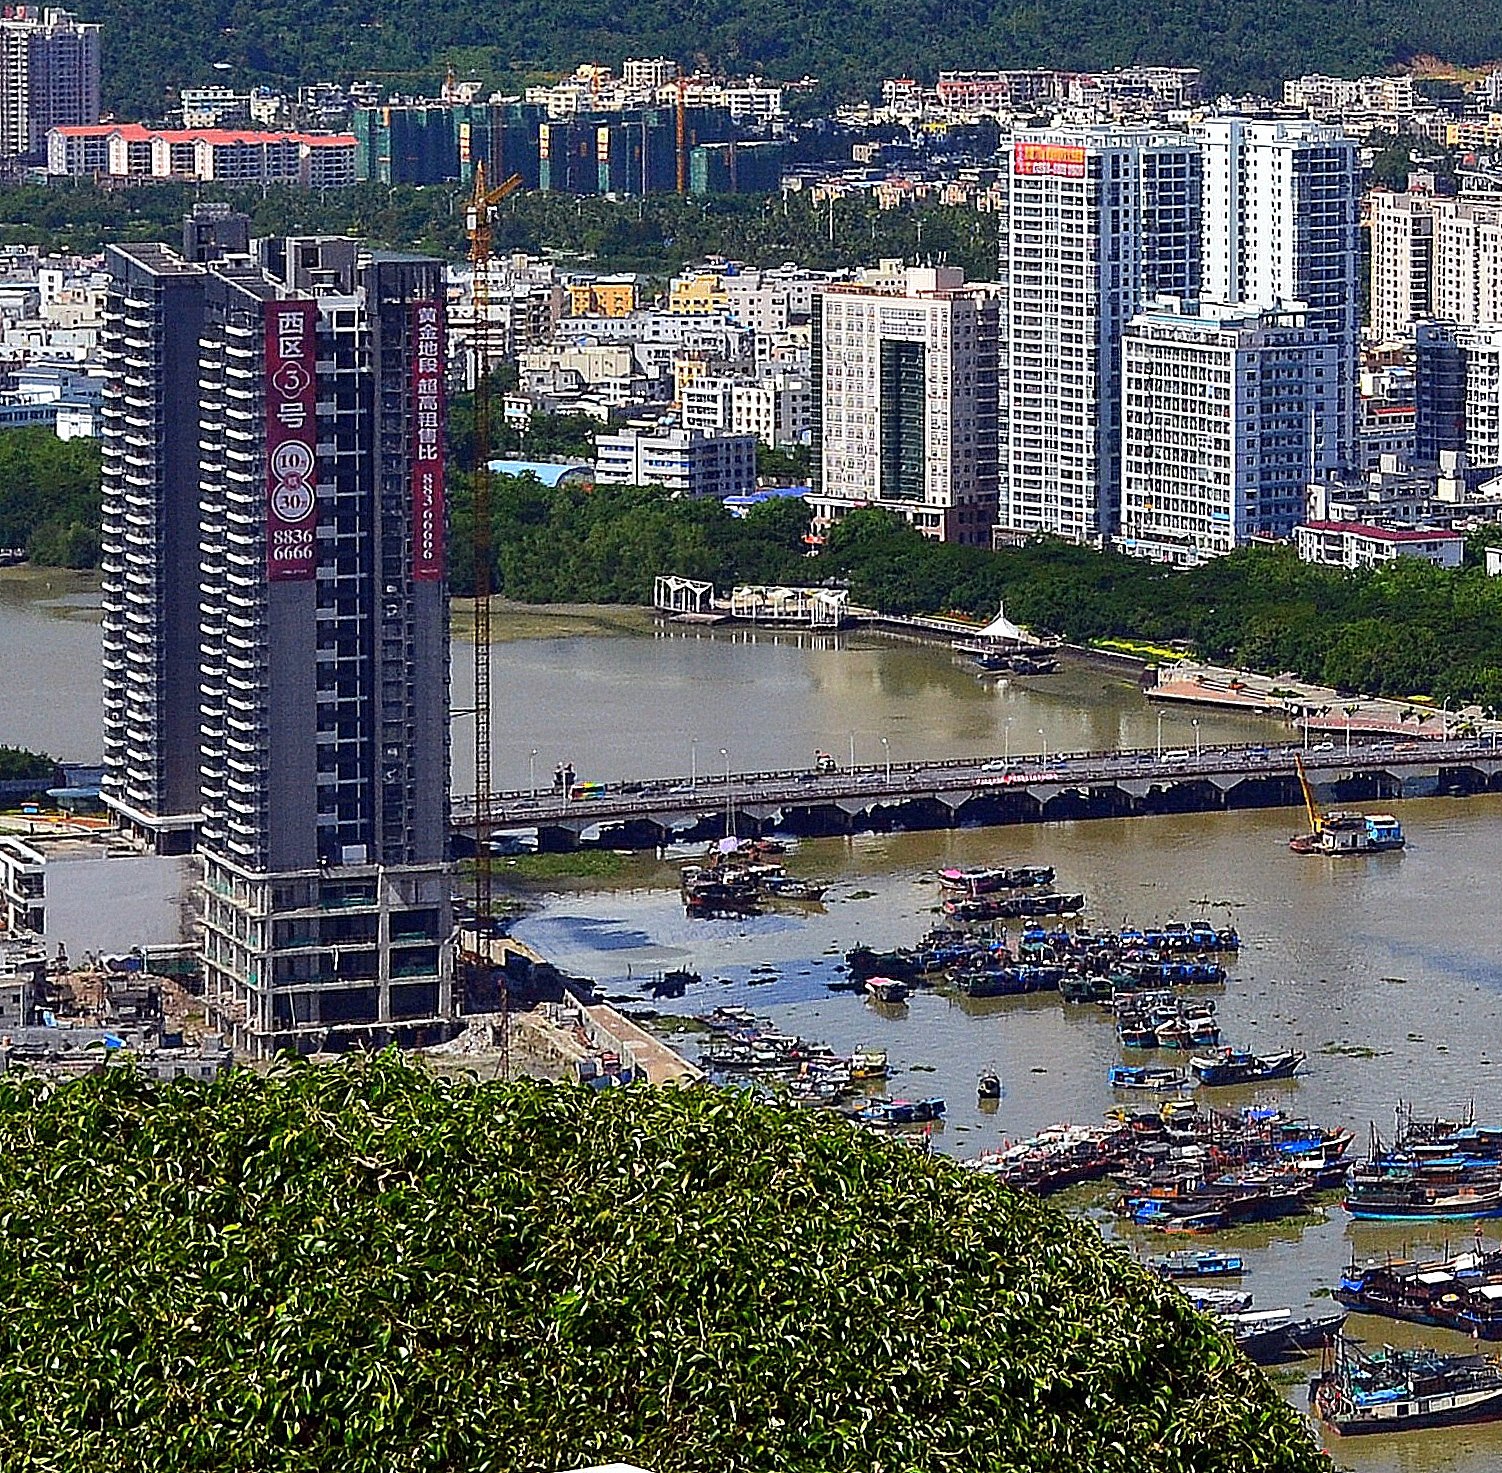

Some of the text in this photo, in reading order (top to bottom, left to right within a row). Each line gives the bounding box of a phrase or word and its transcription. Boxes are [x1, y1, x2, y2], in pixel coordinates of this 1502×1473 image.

[418, 307, 438, 373] 黄金地段
[273, 529, 313, 545] 8836
[273, 546, 313, 561] 6666
